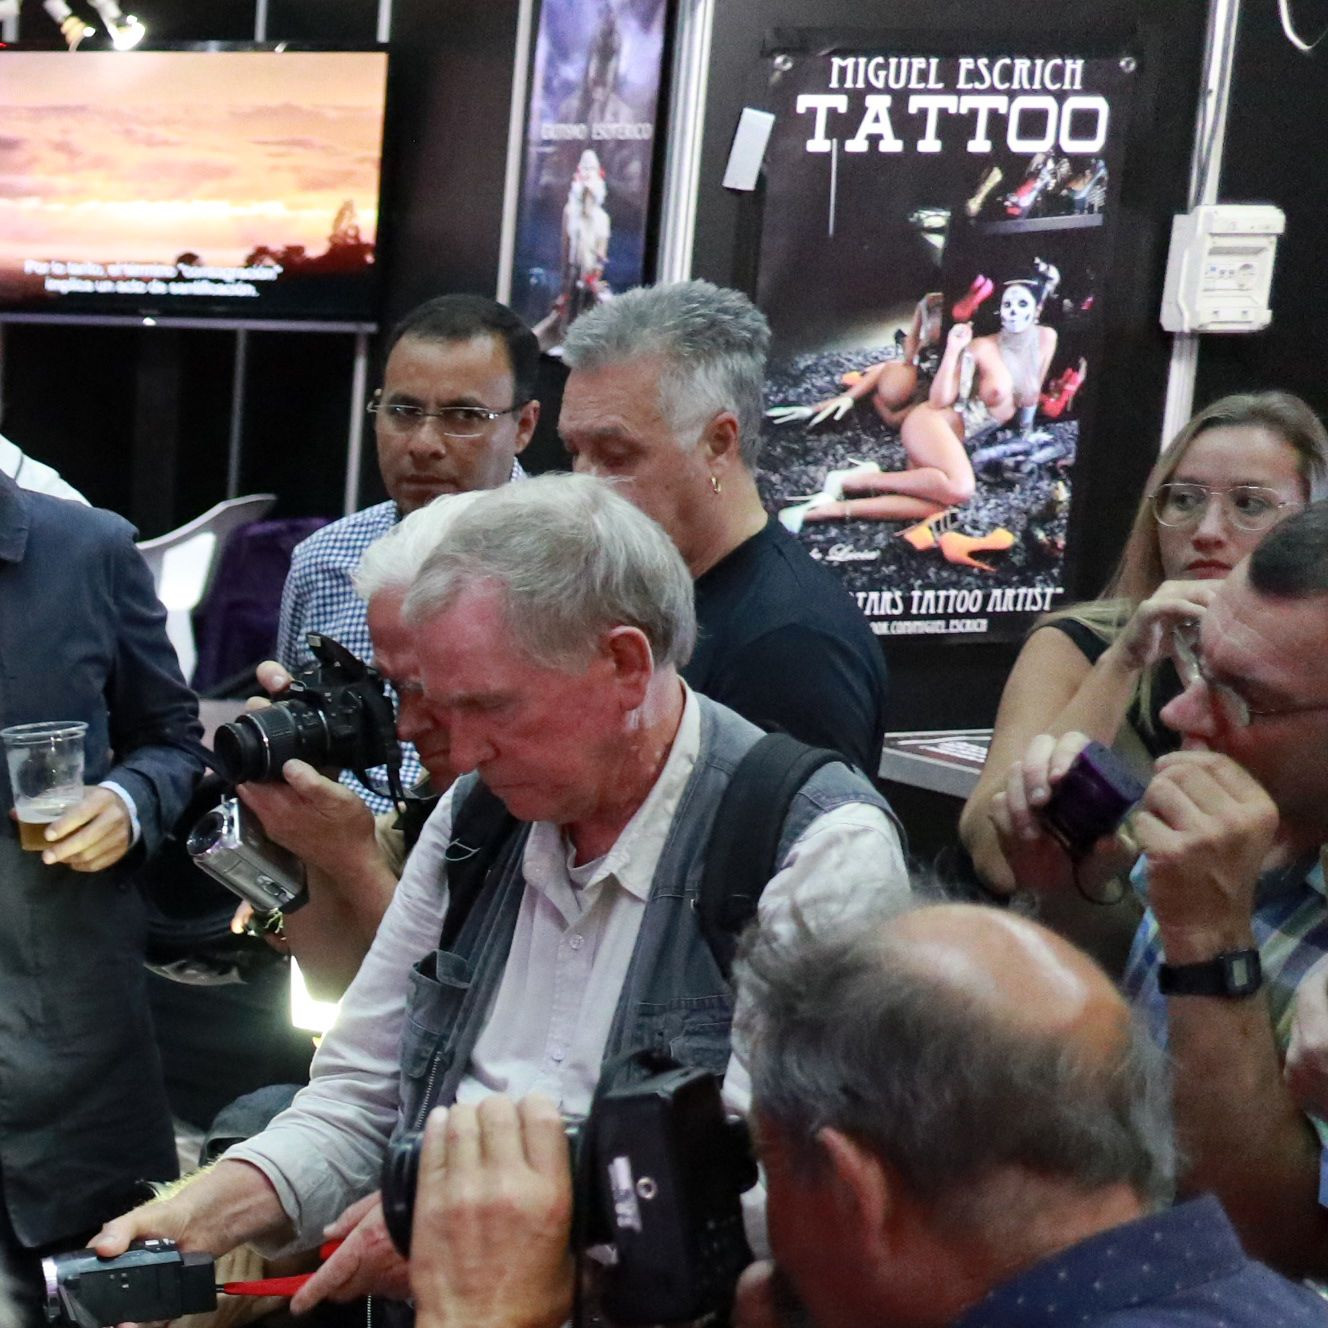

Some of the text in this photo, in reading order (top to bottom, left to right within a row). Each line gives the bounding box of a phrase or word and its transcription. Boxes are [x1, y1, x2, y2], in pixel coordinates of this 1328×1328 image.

[829, 56, 1085, 91] MIGUEL ESCRICH
[796, 93, 1109, 153] TATTOO
[849, 591, 904, 615] TARS
[910, 589, 982, 614] TATTOO
